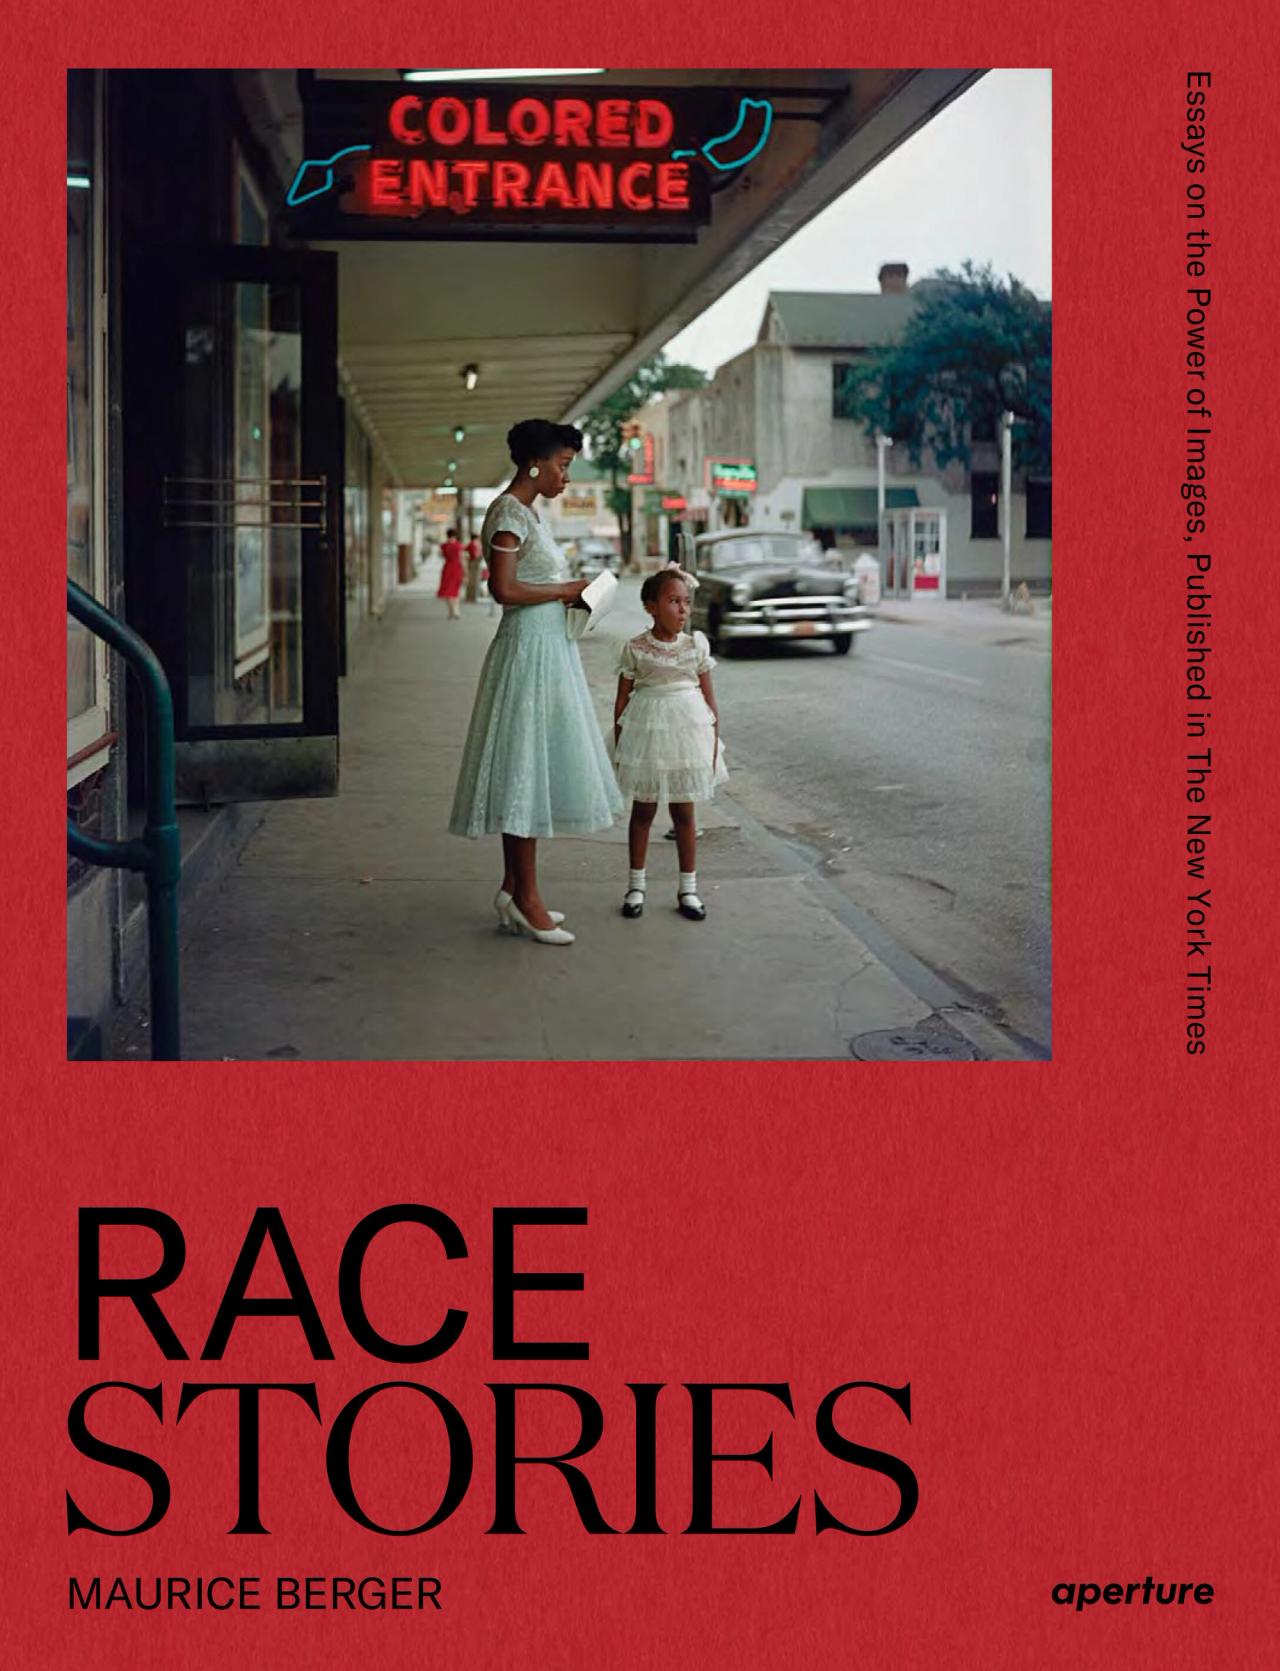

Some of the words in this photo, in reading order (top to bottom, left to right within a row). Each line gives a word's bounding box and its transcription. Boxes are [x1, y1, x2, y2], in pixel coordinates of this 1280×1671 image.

[388, 95, 674, 148] COLORED
[1181, 71, 1212, 174] Essays
[369, 160, 690, 212] ENTRANCE
[1186, 183, 1206, 219] on
[1186, 229, 1212, 277] the
[1186, 288, 1212, 380] Power
[1186, 388, 1212, 418] of
[1181, 428, 1212, 542] Images,
[1186, 554, 1212, 701] Published
[1187, 713, 1212, 737] in
[1187, 747, 1212, 803] The
[1187, 815, 1212, 880] New
[1187, 889, 1212, 957] York
[1186, 965, 1212, 1055] Times
[78, 1204, 590, 1364] RACE
[66, 1381, 919, 1537] STORIES
[69, 1577, 261, 1611] MAURICE
[277, 1577, 442, 1611] BERGER
[1051, 1576, 1215, 1612] aperture
